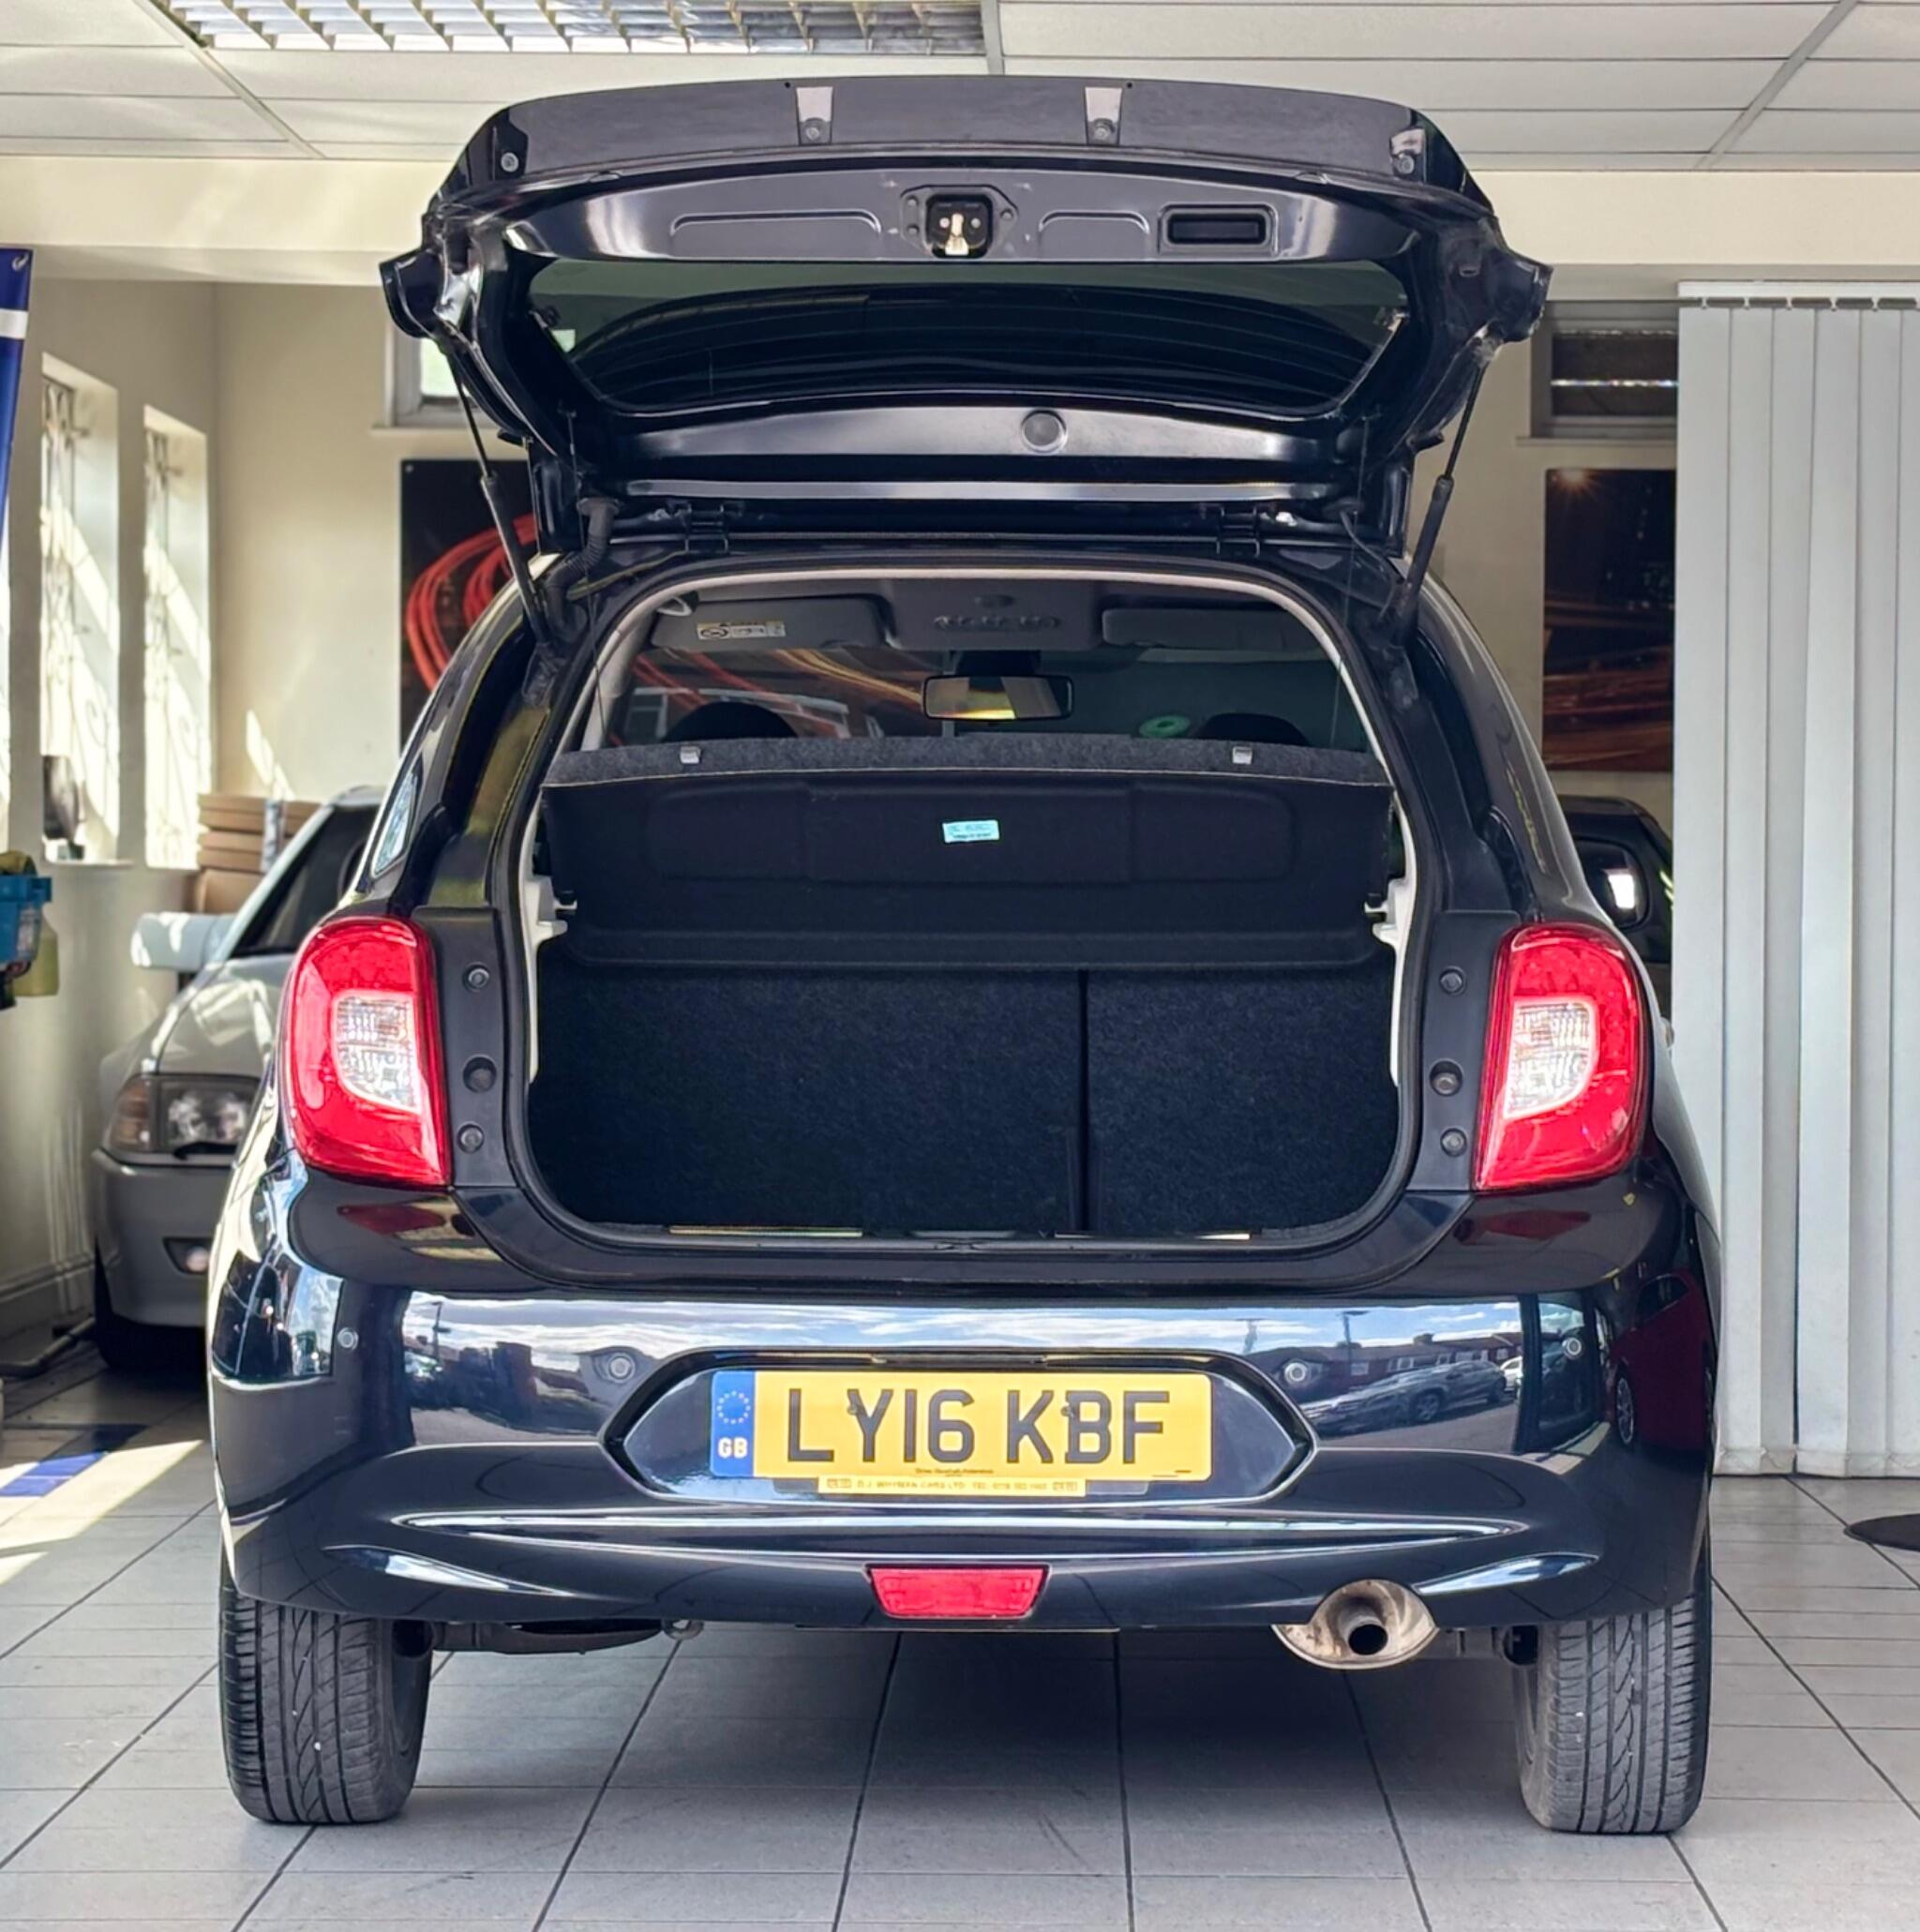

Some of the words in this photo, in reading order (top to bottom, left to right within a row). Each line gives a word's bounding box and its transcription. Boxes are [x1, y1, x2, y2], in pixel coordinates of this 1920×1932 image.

[717, 1437, 748, 1460] GB
[787, 1387, 976, 1464] LY16
[1006, 1389, 1170, 1464] KBF
